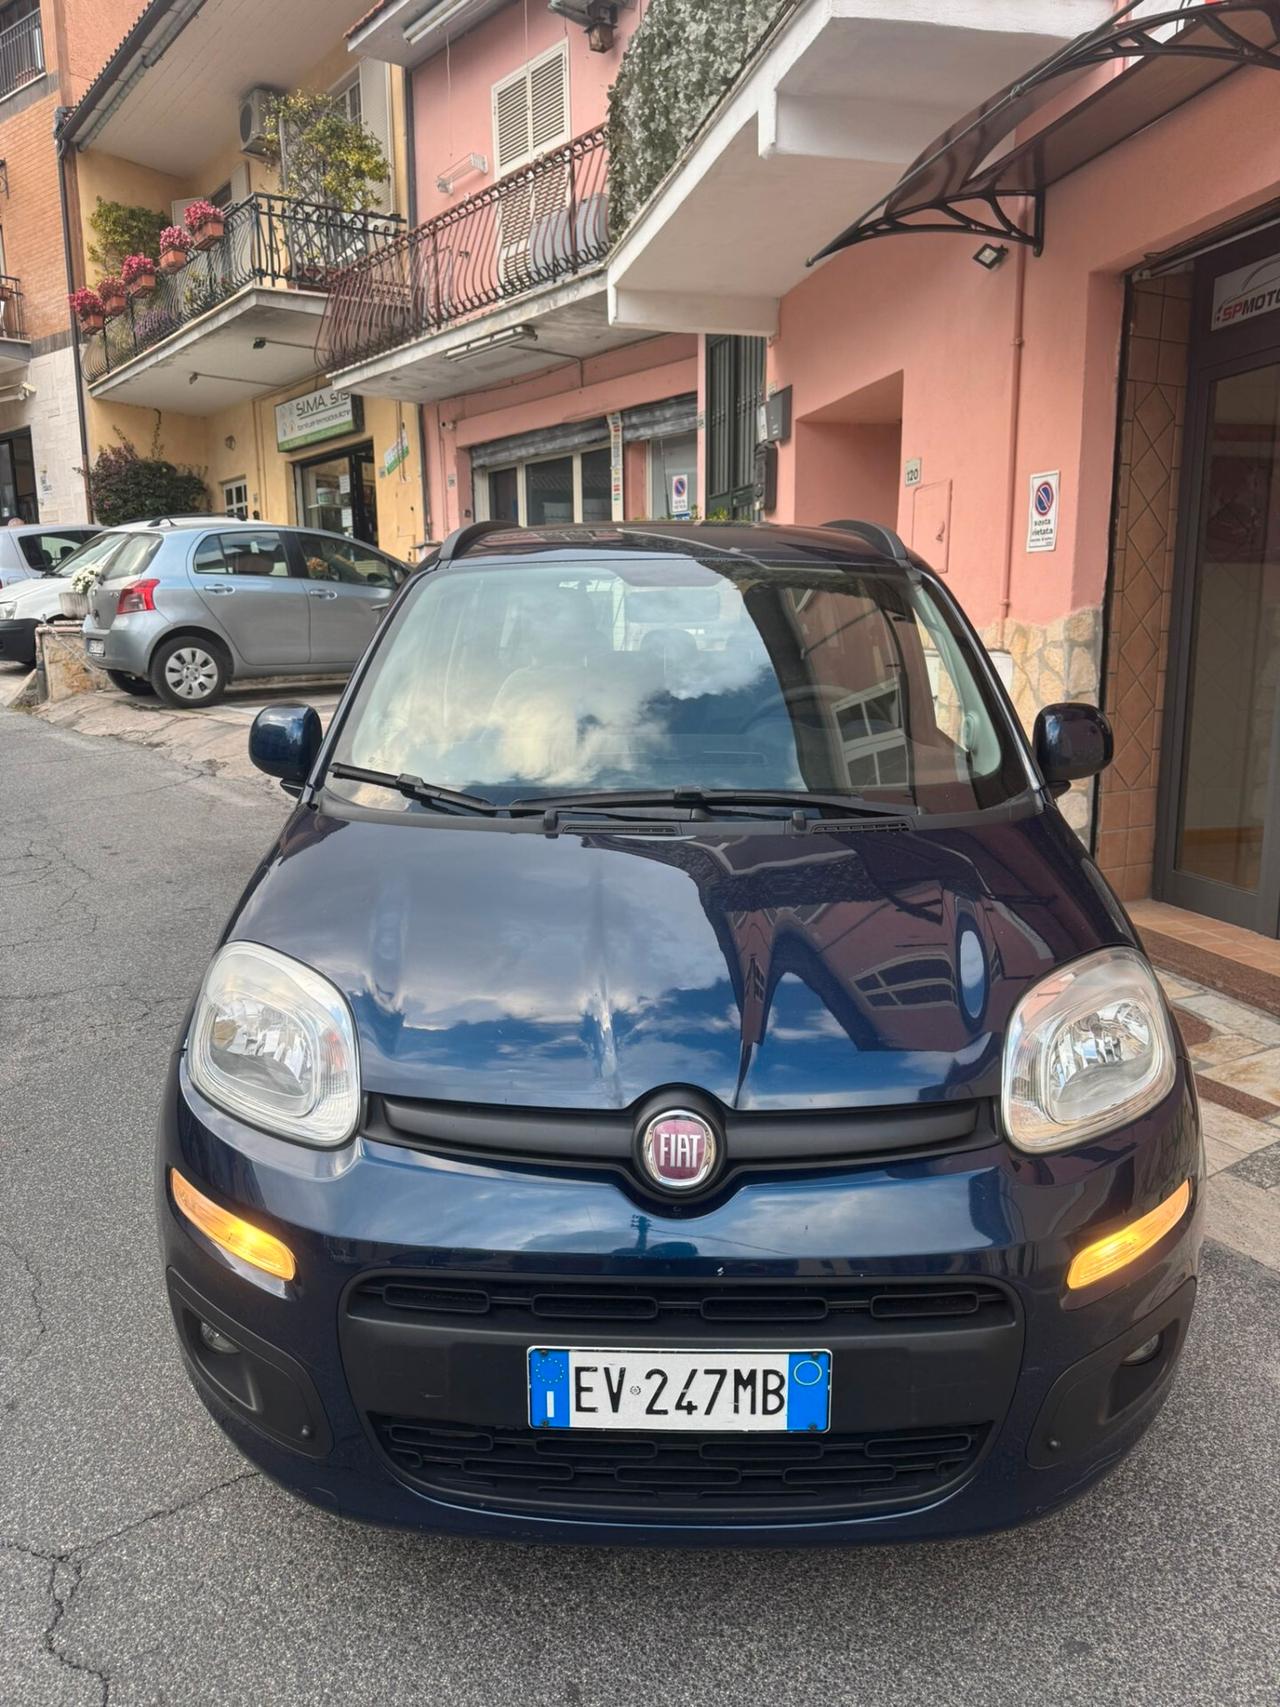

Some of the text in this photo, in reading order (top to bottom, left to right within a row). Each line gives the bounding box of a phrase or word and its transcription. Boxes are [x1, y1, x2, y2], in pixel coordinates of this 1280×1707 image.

[659, 1133, 701, 1168] FIAT
[574, 1366, 786, 1416] EV 247MB
